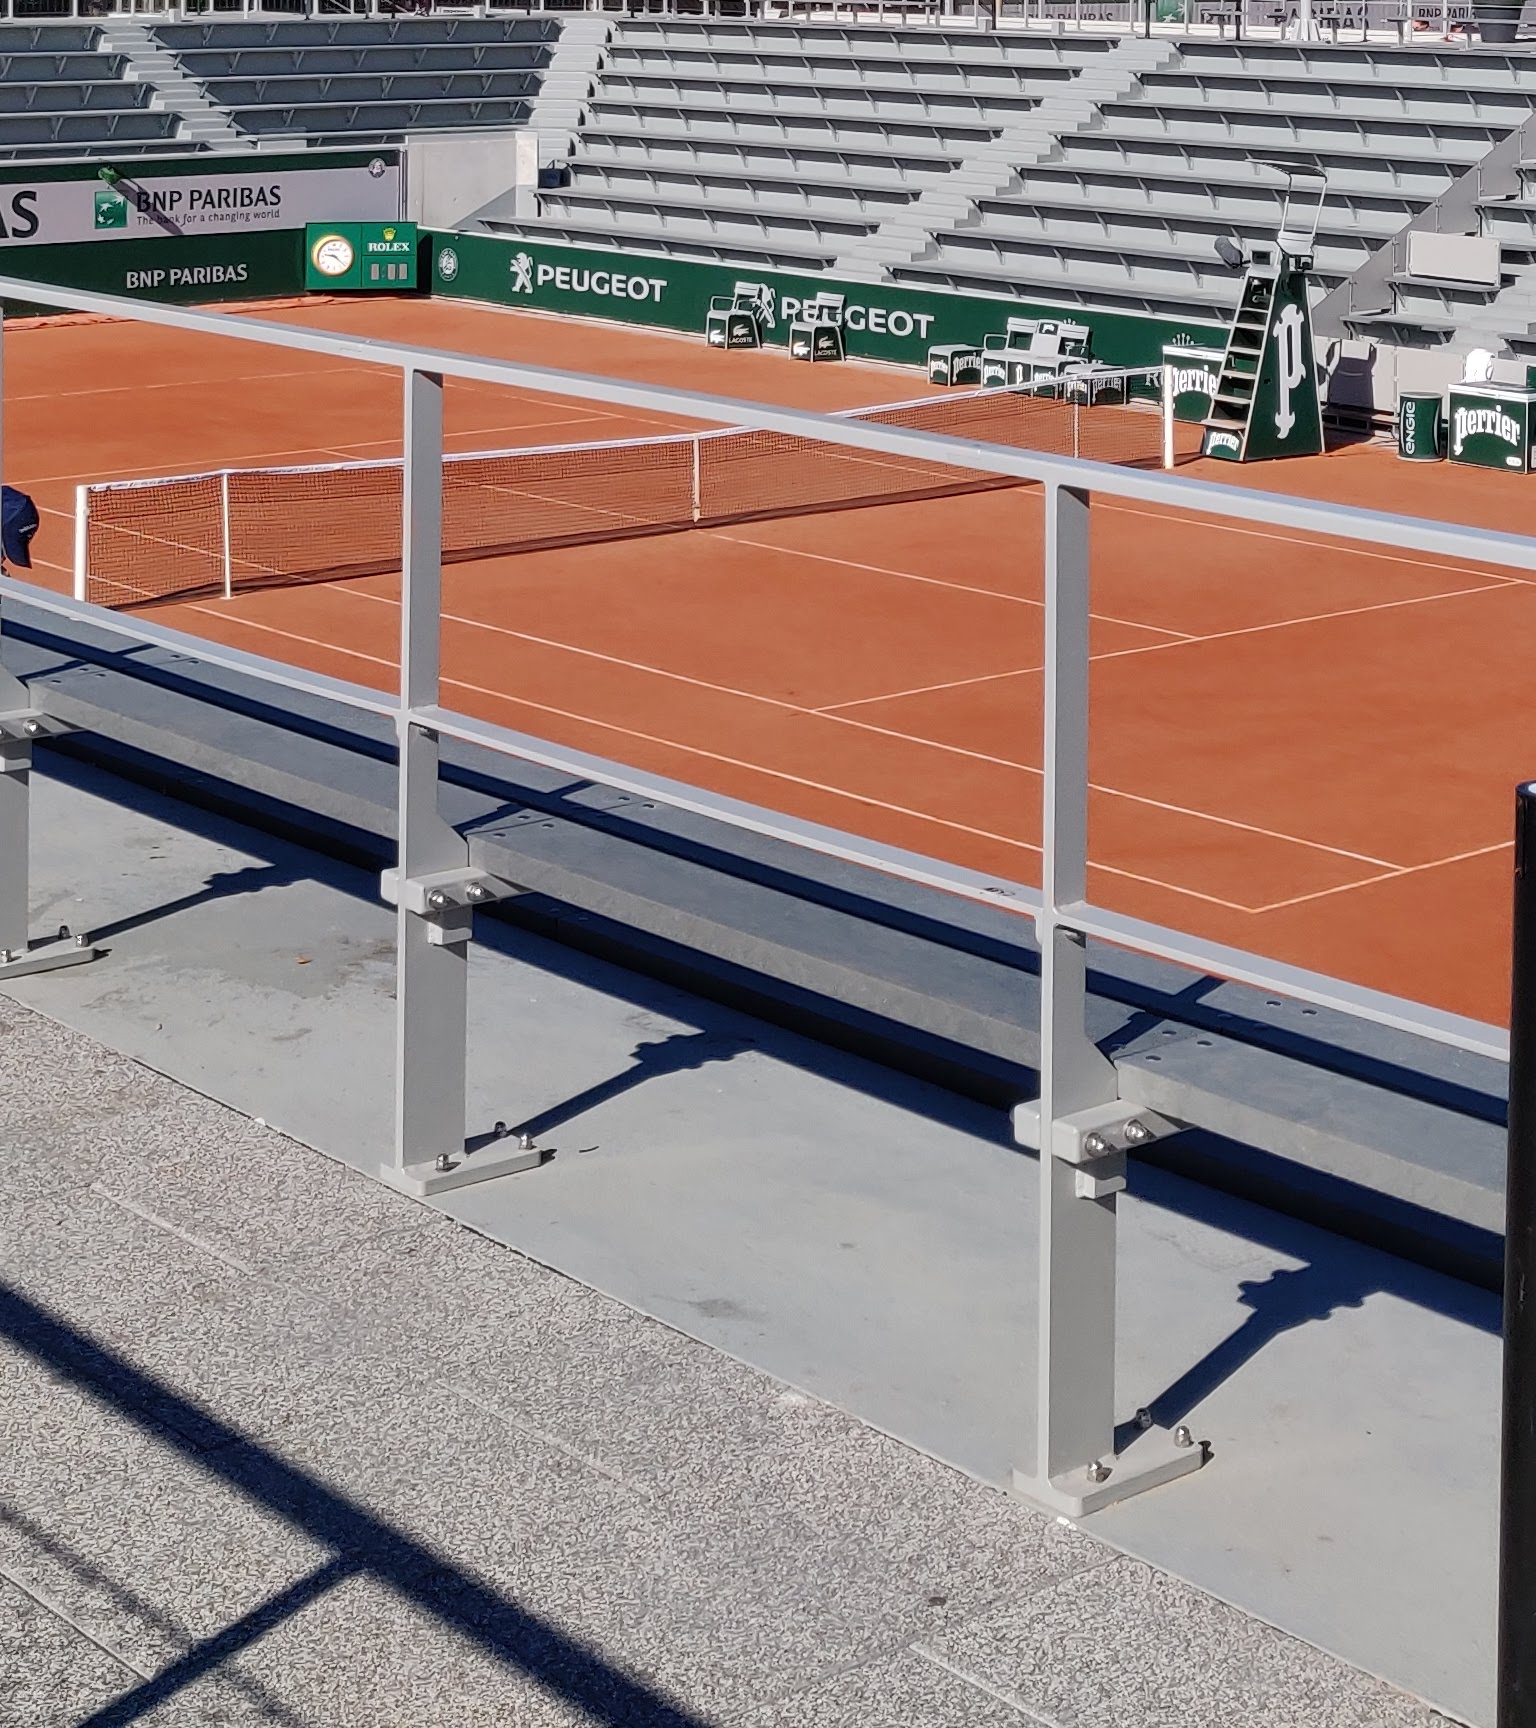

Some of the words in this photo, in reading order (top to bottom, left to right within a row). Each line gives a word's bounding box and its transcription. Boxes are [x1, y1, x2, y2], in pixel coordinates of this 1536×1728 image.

[136, 190, 183, 212] BNP
[189, 185, 282, 210] PARIBAS
[137, 216, 154, 225] The
[182, 213, 197, 227] for
[208, 212, 251, 223] changing
[253, 209, 280, 220] world
[368, 242, 410, 252] ROLEX
[126, 269, 165, 289] BNP
[170, 263, 248, 286] PARIBAS
[537, 264, 668, 303] PEUGEOT
[729, 336, 753, 344] LACOSTE
[952, 352, 981, 383] perrie
[1454, 405, 1521, 456] perrier
[1206, 432, 1240, 456] perrier
